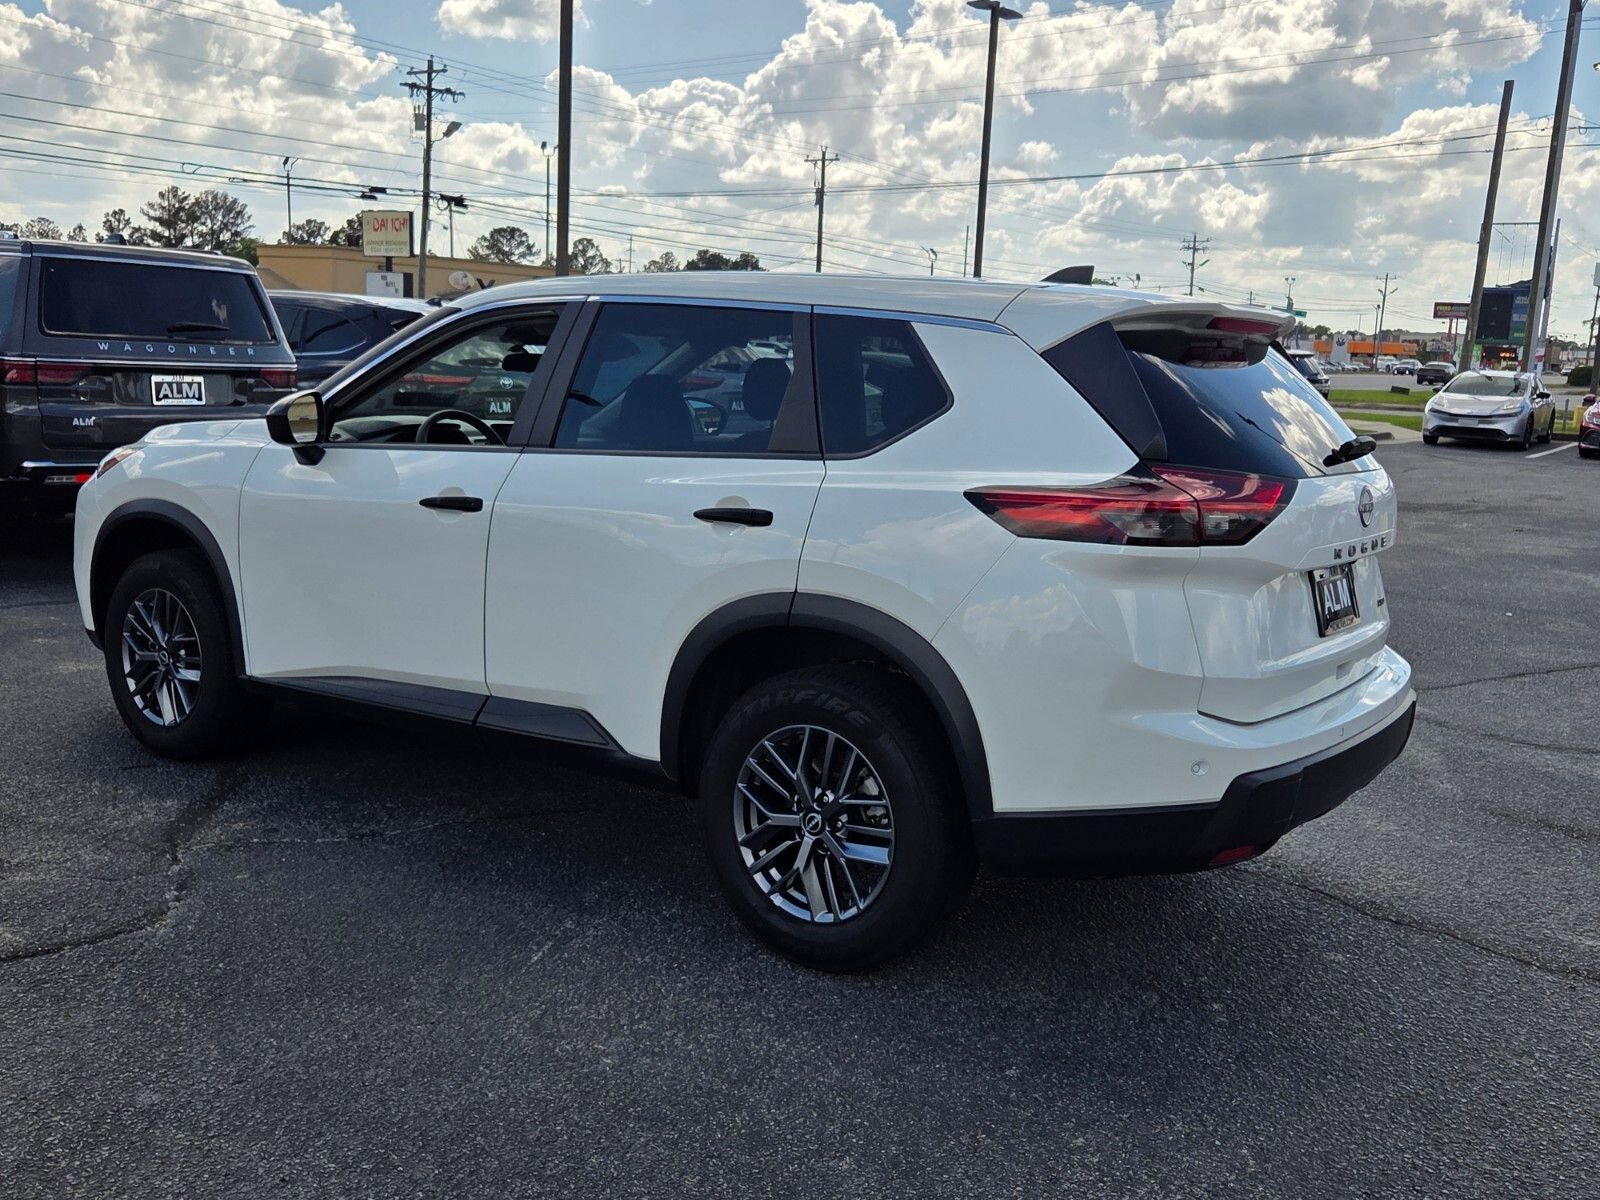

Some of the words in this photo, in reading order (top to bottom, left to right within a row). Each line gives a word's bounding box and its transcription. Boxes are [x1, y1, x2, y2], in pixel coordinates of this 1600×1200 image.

[97, 341, 255, 356] WAGONEER
[159, 383, 199, 398] ALM
[489, 401, 511, 413] ALM
[72, 417, 94, 426] ALM
[1333, 536, 1387, 560] ROGUE
[1323, 578, 1351, 615] ALM
